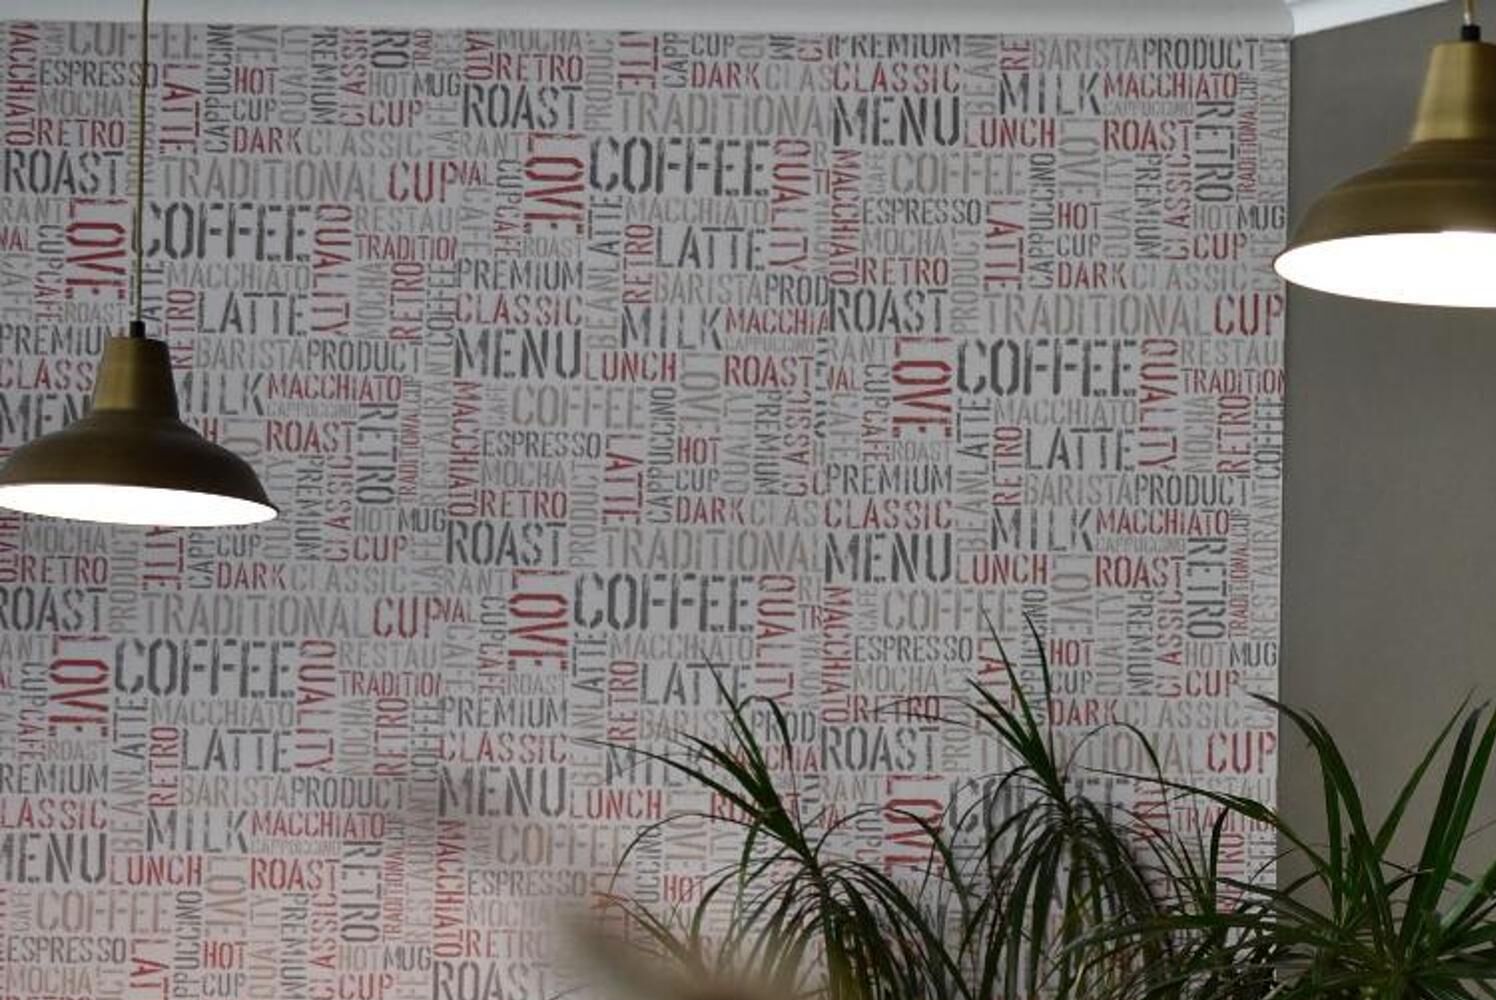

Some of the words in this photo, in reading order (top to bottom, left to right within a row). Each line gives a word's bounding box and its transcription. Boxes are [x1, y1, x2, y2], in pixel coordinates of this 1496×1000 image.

[496, 53, 584, 84] RETRO
[691, 60, 761, 91] DARK
[1142, 36, 1259, 71] PRODUCT
[233, 65, 280, 96] HOT
[413, 72, 462, 98] MUG
[831, 61, 960, 95] CLASSIC
[998, 71, 1102, 116] MILK
[1104, 71, 1238, 100] MACCHIATO
[158, 63, 201, 156] LATTE
[367, 98, 424, 128] CUP
[462, 83, 583, 130] ROAST
[831, 96, 960, 148] MENU
[37, 118, 126, 149] RETRO
[233, 125, 303, 156] DARK
[306, 128, 423, 158] CLASSIC
[964, 117, 1057, 150] LUNCH
[1103, 119, 1194, 152] ROAST
[1193, 101, 1236, 203] RETRO
[3, 149, 124, 196] ROAST
[158, 157, 388, 202] TRADITIONAL
[389, 159, 460, 203] CUP
[523, 132, 585, 234] LOVE
[589, 136, 770, 196] COFFEE
[891, 150, 1027, 195] COFFEE
[769, 137, 810, 272] QUALITY
[828, 148, 862, 286] MACCHIATO
[862, 198, 983, 226] ESPRESSO
[1027, 151, 1057, 290] CAPPUCCINO
[1057, 200, 1104, 231] HOT
[1133, 153, 1162, 260] PREMIUM
[1162, 152, 1193, 263] CLASSIC
[1237, 204, 1286, 231] MUG
[65, 197, 127, 300] LOVE
[130, 201, 312, 261] COFFEE
[656, 226, 767, 270] LATTE
[862, 227, 950, 256] MOCHA
[982, 199, 1025, 292] LATTE
[1192, 231, 1249, 261] CUP
[310, 203, 352, 337] QUALITY
[457, 258, 583, 292] PREMIUM
[861, 256, 950, 287] RETRO
[1057, 260, 1127, 291] DARK
[198, 291, 309, 335] LATTE
[454, 293, 582, 327] CLASSIC
[620, 305, 724, 350] MILK
[828, 287, 949, 334] ROAST
[983, 292, 1213, 337] TRADITIONAL
[1214, 292, 1285, 336] CUP
[196, 336, 302, 371] BARISTA
[306, 338, 423, 373] PRODUCT
[453, 328, 581, 379] MENU
[585, 350, 678, 383] LUNCH
[724, 355, 815, 388] ROAST
[956, 337, 1138, 397] COFFEE
[1180, 339, 1279, 368] RESTAU
[267, 372, 401, 401] MACCHIATO
[511, 383, 647, 428] COFFEE
[891, 335, 953, 438] LOVE
[1137, 337, 1179, 472] QUALITY
[266, 420, 356, 454] ROAST
[355, 403, 398, 505] RETRO
[447, 380, 481, 518] MACCHIATO
[481, 431, 603, 459] ESPRESSO
[647, 385, 677, 524] CAPPUCCINO
[1025, 427, 1136, 471] LATTE
[601, 433, 644, 526] LATTE
[826, 462, 952, 496] PREMIUM
[398, 507, 447, 534] MUG
[479, 489, 569, 520] RETRO
[823, 497, 952, 531] CLASSIC
[1096, 507, 1230, 536] MACCHIATO
[353, 533, 410, 563] CUP
[446, 520, 567, 567] ROAST
[990, 507, 1094, 552] MILK
[216, 561, 286, 592] DARK
[823, 532, 952, 584] MENU
[956, 553, 1049, 586] LUNCH
[1095, 555, 1186, 589] ROAST
[573, 572, 756, 632] COFFEE
[883, 586, 1019, 632] COFFEE
[1185, 537, 1228, 640] RETRO
[141, 593, 372, 638] TRADITIONAL
[373, 595, 444, 639] CUP
[508, 568, 570, 671] LOVE
[754, 573, 796, 708] QUALITY
[820, 584, 854, 724] MACCHIATO
[854, 635, 975, 663] ESPRESSO
[1049, 637, 1096, 668] HOT
[1229, 641, 1278, 668] MUG
[20, 662, 49, 708] CUP
[48, 634, 110, 738] LOVE
[114, 638, 296, 698] COFFEE
[641, 662, 752, 706] LATTE
[294, 639, 337, 774] QUALITY
[441, 695, 567, 729] PREMIUM
[1049, 697, 1119, 729] DARK
[17, 708, 46, 762] CAFE
[113, 697, 147, 776] LATTE
[182, 728, 293, 773] LATTE
[437, 730, 567, 764] CLASSIC
[820, 725, 941, 772] ROAST
[1206, 729, 1278, 774] CUP
[290, 775, 407, 810] PRODUCT
[437, 765, 566, 818] MENU
[570, 788, 663, 821] LUNCH
[145, 808, 249, 854] MILK
[252, 810, 386, 839] MACCHIATO
[111, 854, 204, 887] LUNCH
[250, 858, 341, 892] ROAST
[340, 840, 383, 944] RETRO
[432, 818, 466, 958] MACCHIATO
[467, 870, 588, 898] ESPRESSO
[36, 888, 173, 933] COFFEE
[6, 936, 128, 965] ESPRESSO
[203, 939, 250, 970] HOT
[279, 893, 308, 1000] PREMIUM
[383, 945, 432, 972] MUG
[6, 966, 94, 995] MOCHA
